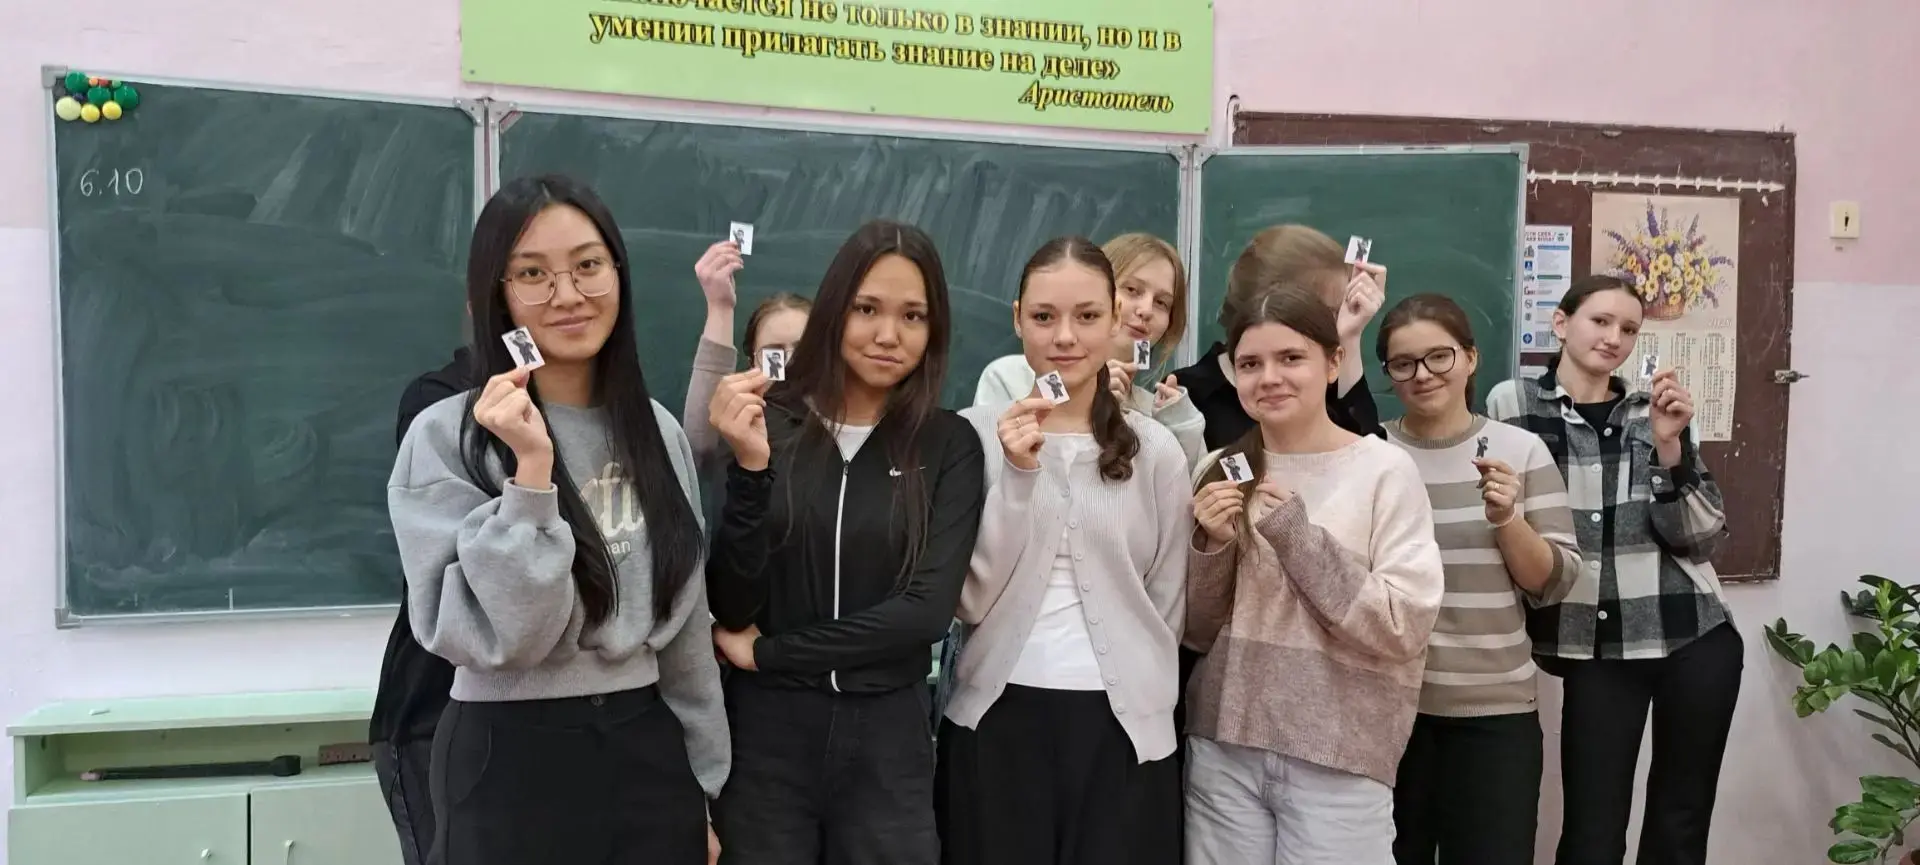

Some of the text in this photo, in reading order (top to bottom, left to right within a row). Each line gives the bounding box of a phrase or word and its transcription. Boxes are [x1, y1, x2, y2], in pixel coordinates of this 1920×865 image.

[589, 12, 1120, 80] умении прилагать знание на деле»
[844, 3, 949, 33] только
[955, 11, 974, 35] в
[980, 14, 1091, 50] знании,
[1097, 24, 1132, 48] но
[1138, 28, 1157, 49] и
[1163, 29, 1181, 51] в
[1018, 79, 1174, 113] Аристотель
[80, 167, 144, 197] 6.10
